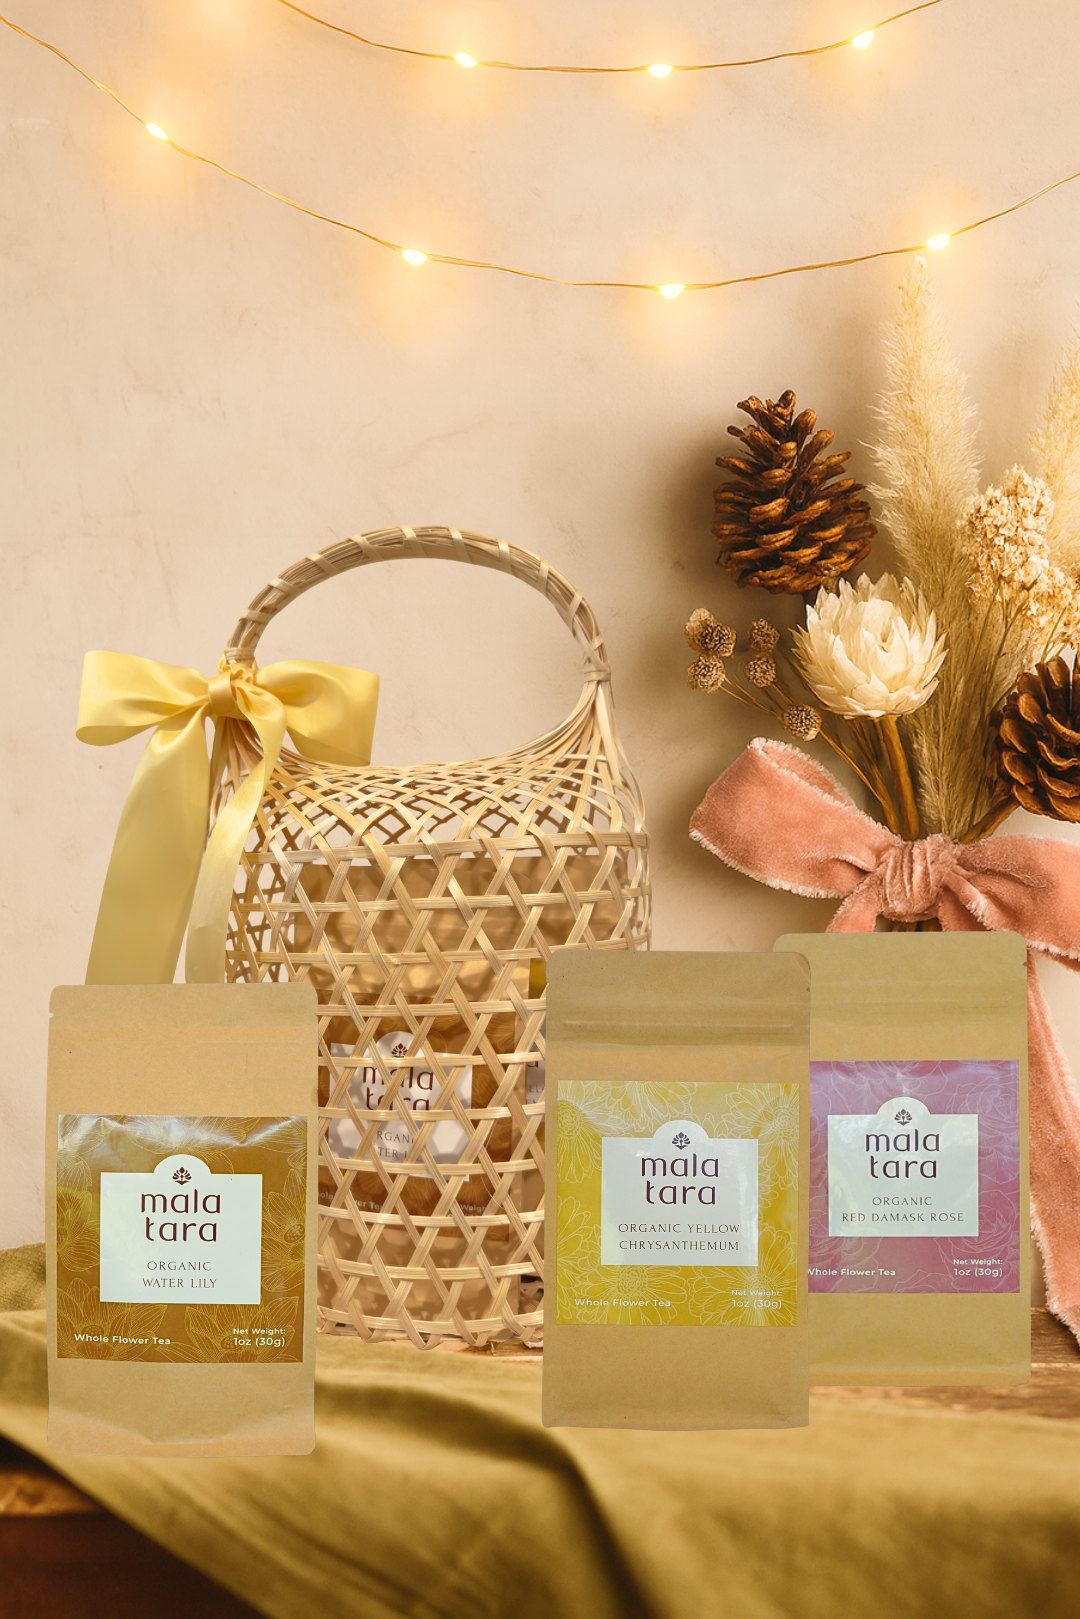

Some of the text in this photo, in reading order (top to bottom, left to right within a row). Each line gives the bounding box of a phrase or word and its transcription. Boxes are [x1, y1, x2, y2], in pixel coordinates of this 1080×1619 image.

[866, 1129, 940, 1152] mala
[641, 1153, 719, 1178] mala
[870, 1156, 937, 1179] tara
[646, 1180, 716, 1205] tara
[141, 1189, 221, 1214] mala
[872, 1197, 932, 1206] ORGANIC
[842, 1213, 964, 1222] RED DAMASK ROSE
[146, 1217, 217, 1242] tara
[618, 1223, 740, 1234] ORGANIC YELLOW
[619, 1240, 739, 1251] CHRYSANTHEMUM
[146, 1261, 212, 1271] ORGANIC
[970, 1258, 1003, 1266] Weight:
[808, 1268, 837, 1276] Whole
[841, 1268, 875, 1276] Flower
[953, 1267, 1003, 1278] 1oz (30g)
[142, 1278, 217, 1289] WATER LILY
[749, 1289, 783, 1298] Weight:
[575, 1299, 671, 1307] Whole Flower Tea
[731, 1299, 782, 1310] 1oz (30g)
[251, 1327, 286, 1336] Weight:
[74, 1333, 171, 1345] Whole Flower Tea
[233, 1337, 285, 1348] 1oz (30g)
